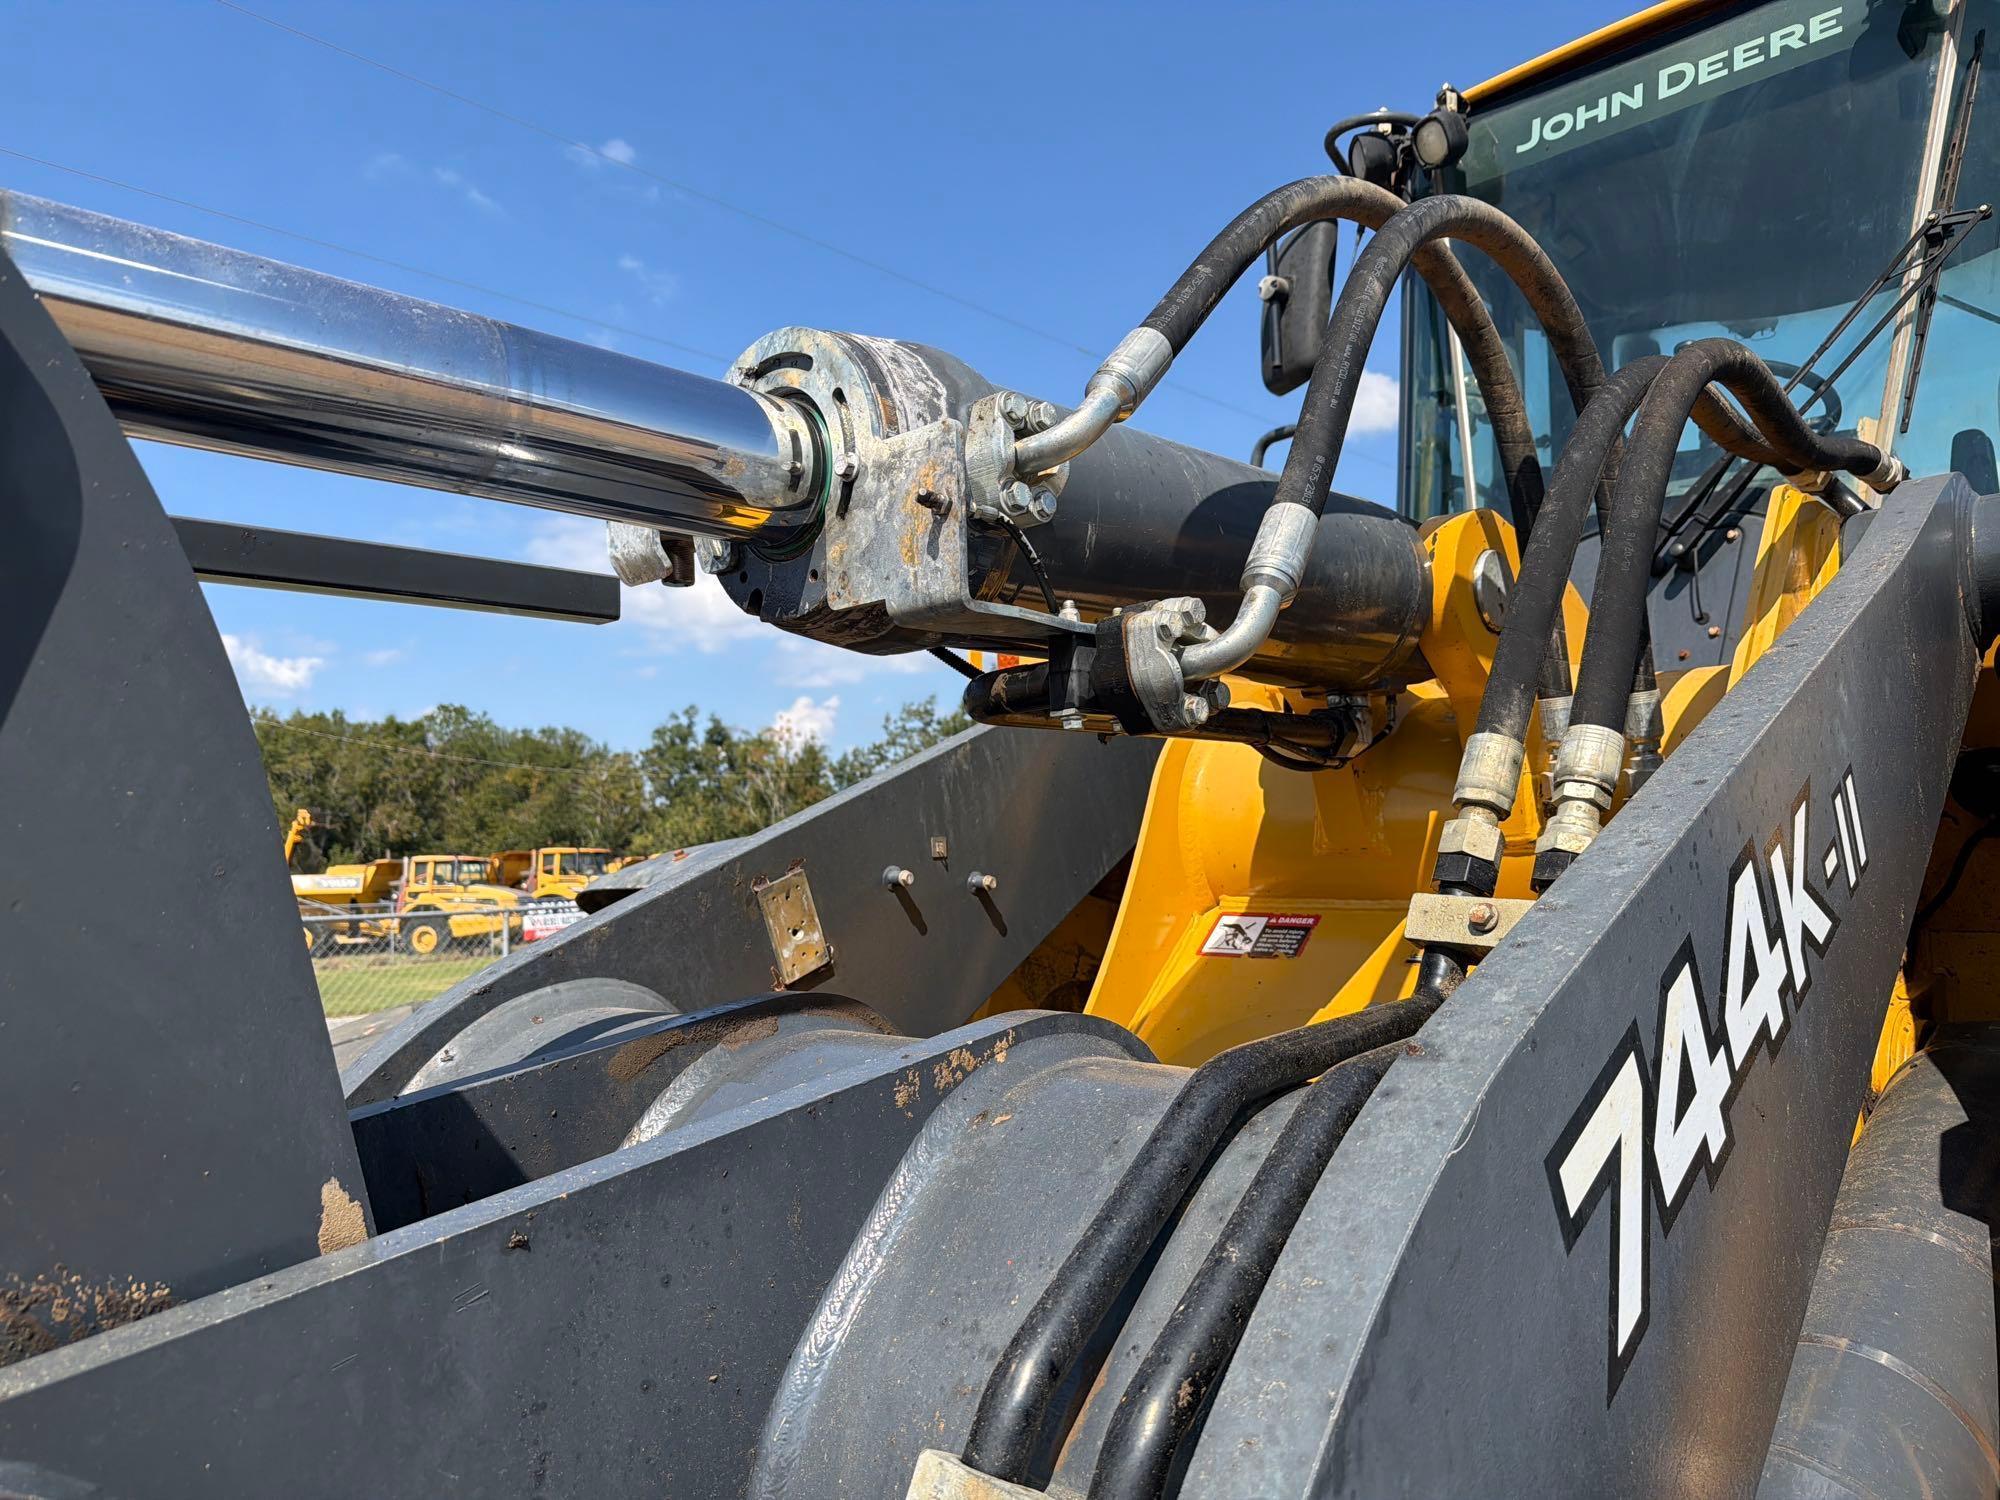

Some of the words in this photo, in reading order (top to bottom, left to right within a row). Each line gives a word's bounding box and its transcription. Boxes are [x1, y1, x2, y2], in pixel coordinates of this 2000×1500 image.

[1515, 83, 1643, 154] JOHN
[1657, 6, 1843, 100] DEERE
[1278, 917, 1314, 925] DANGER
